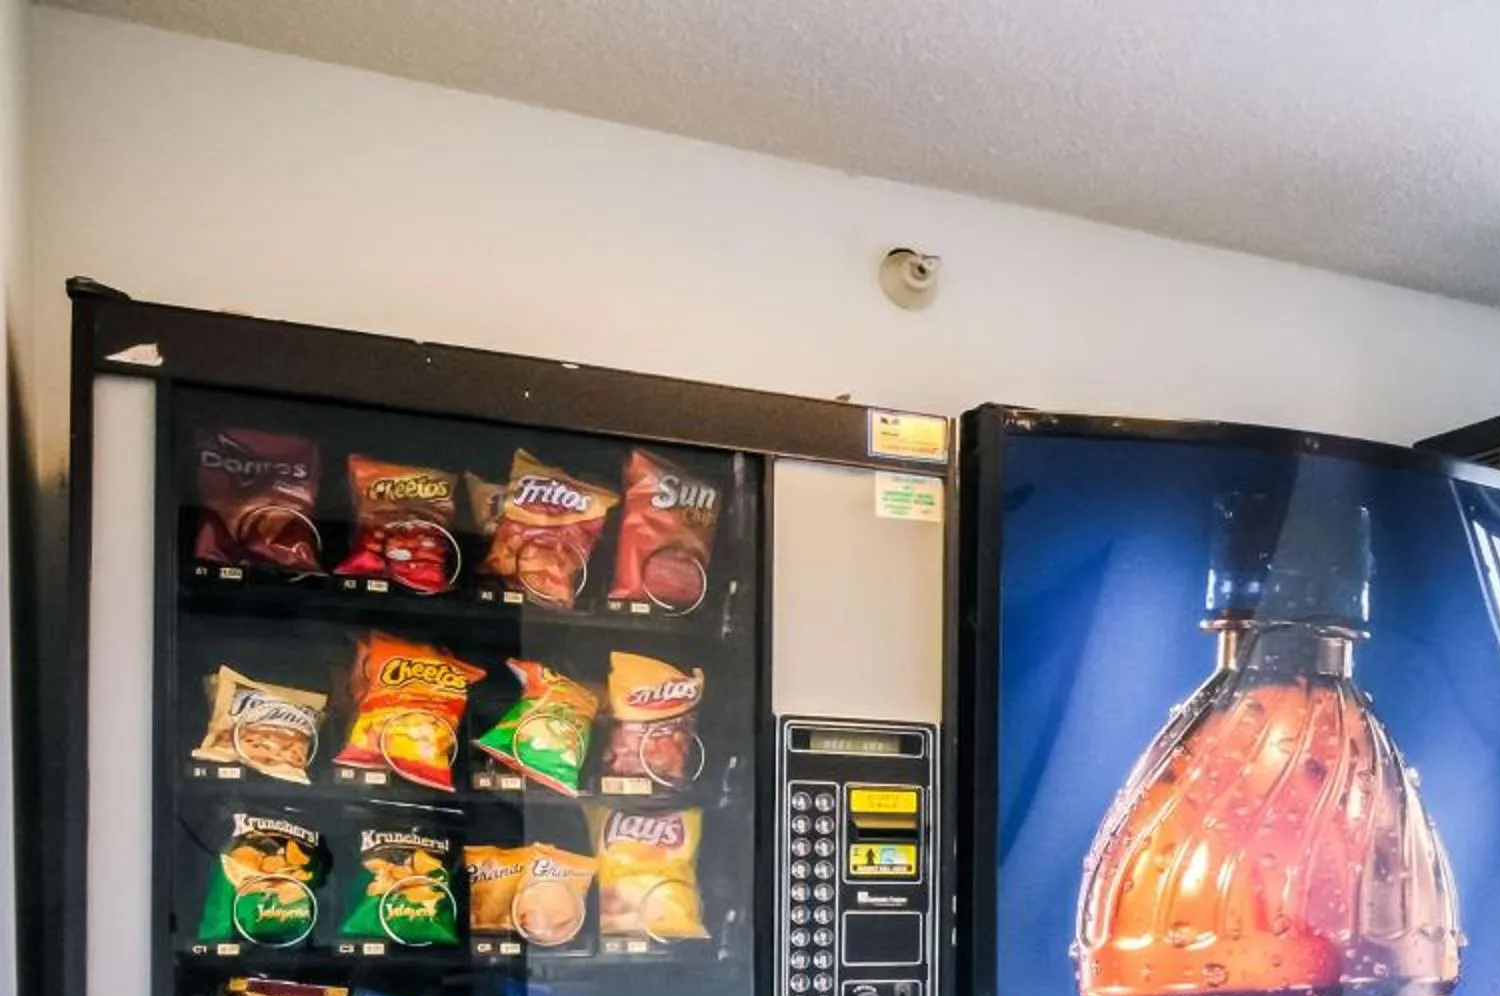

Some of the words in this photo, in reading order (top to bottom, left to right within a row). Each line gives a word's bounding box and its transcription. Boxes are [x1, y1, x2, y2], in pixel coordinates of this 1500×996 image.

[201, 450, 309, 479] Doritos
[370, 475, 450, 501] Cheetos
[512, 474, 593, 512] Fritos
[651, 474, 717, 509] Sun
[380, 656, 469, 690] Cheetos
[232, 812, 320, 847] Krunchers!
[360, 829, 450, 852] Krunchers!
[607, 811, 683, 846] Lay's
